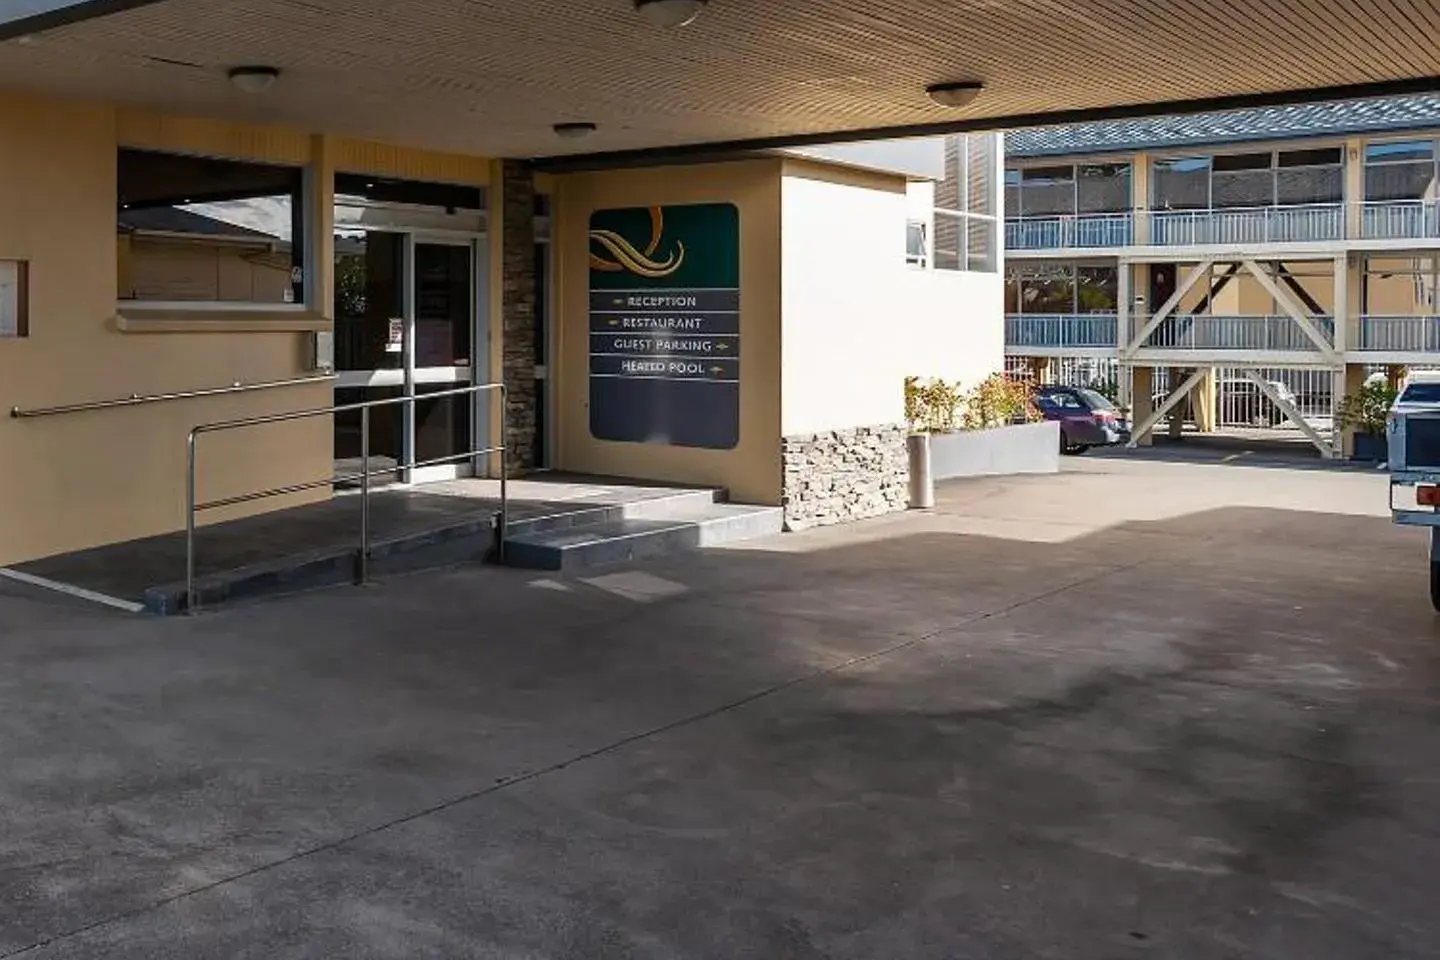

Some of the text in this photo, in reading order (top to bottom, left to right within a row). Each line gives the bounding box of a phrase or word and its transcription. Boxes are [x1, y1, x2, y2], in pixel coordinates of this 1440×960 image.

[627, 296, 696, 307] RECEPTION
[623, 318, 702, 329] RESTAURANT
[614, 339, 712, 352] GUEST PARKING
[622, 360, 705, 373] HEATED POOL
